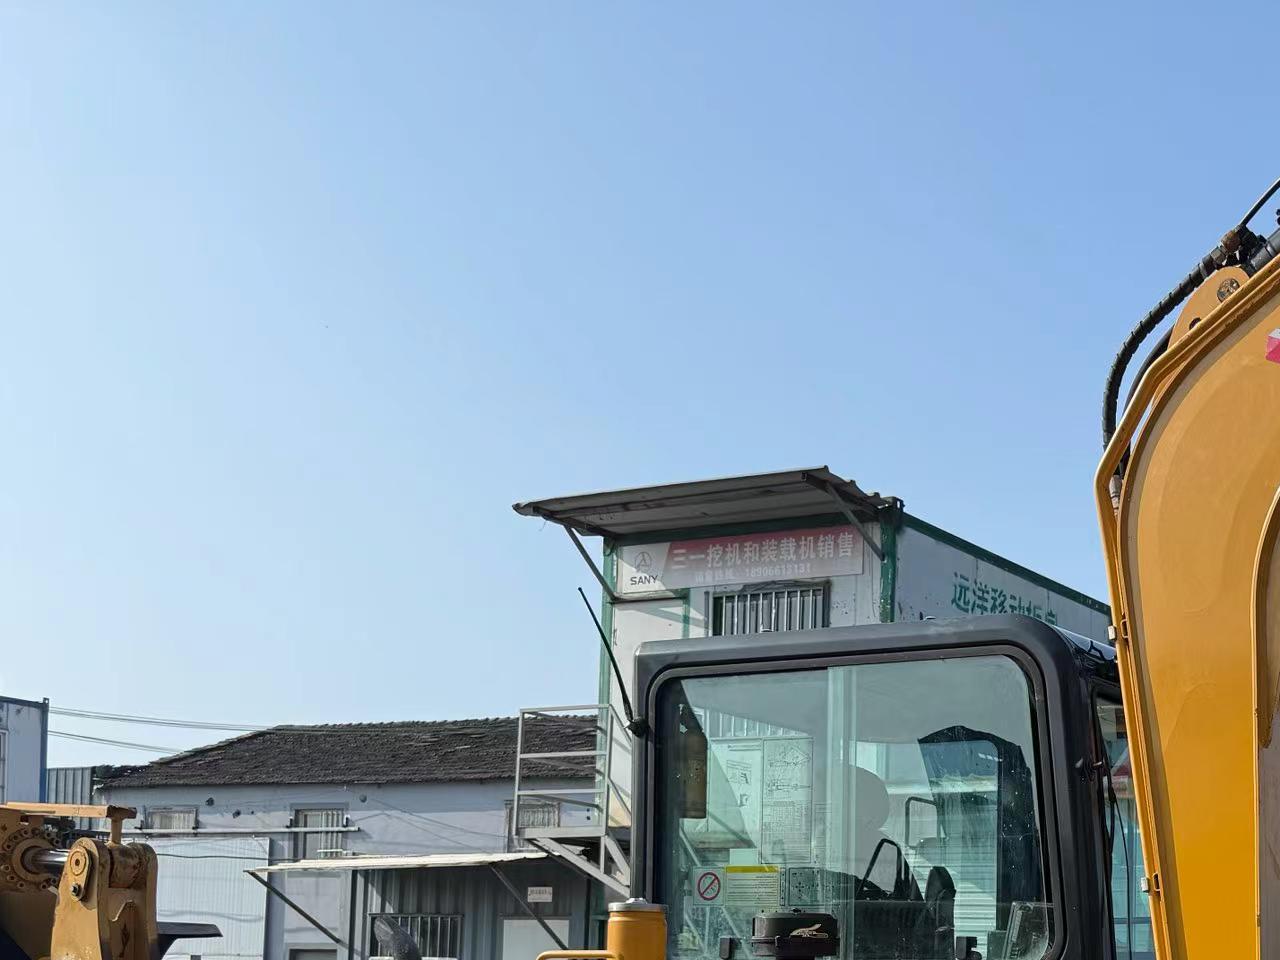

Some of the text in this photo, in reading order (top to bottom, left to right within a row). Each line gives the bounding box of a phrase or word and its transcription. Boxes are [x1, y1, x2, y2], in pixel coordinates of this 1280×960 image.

[671, 532, 854, 571] 三一挖机和装载机销售
[630, 574, 658, 586] SANY
